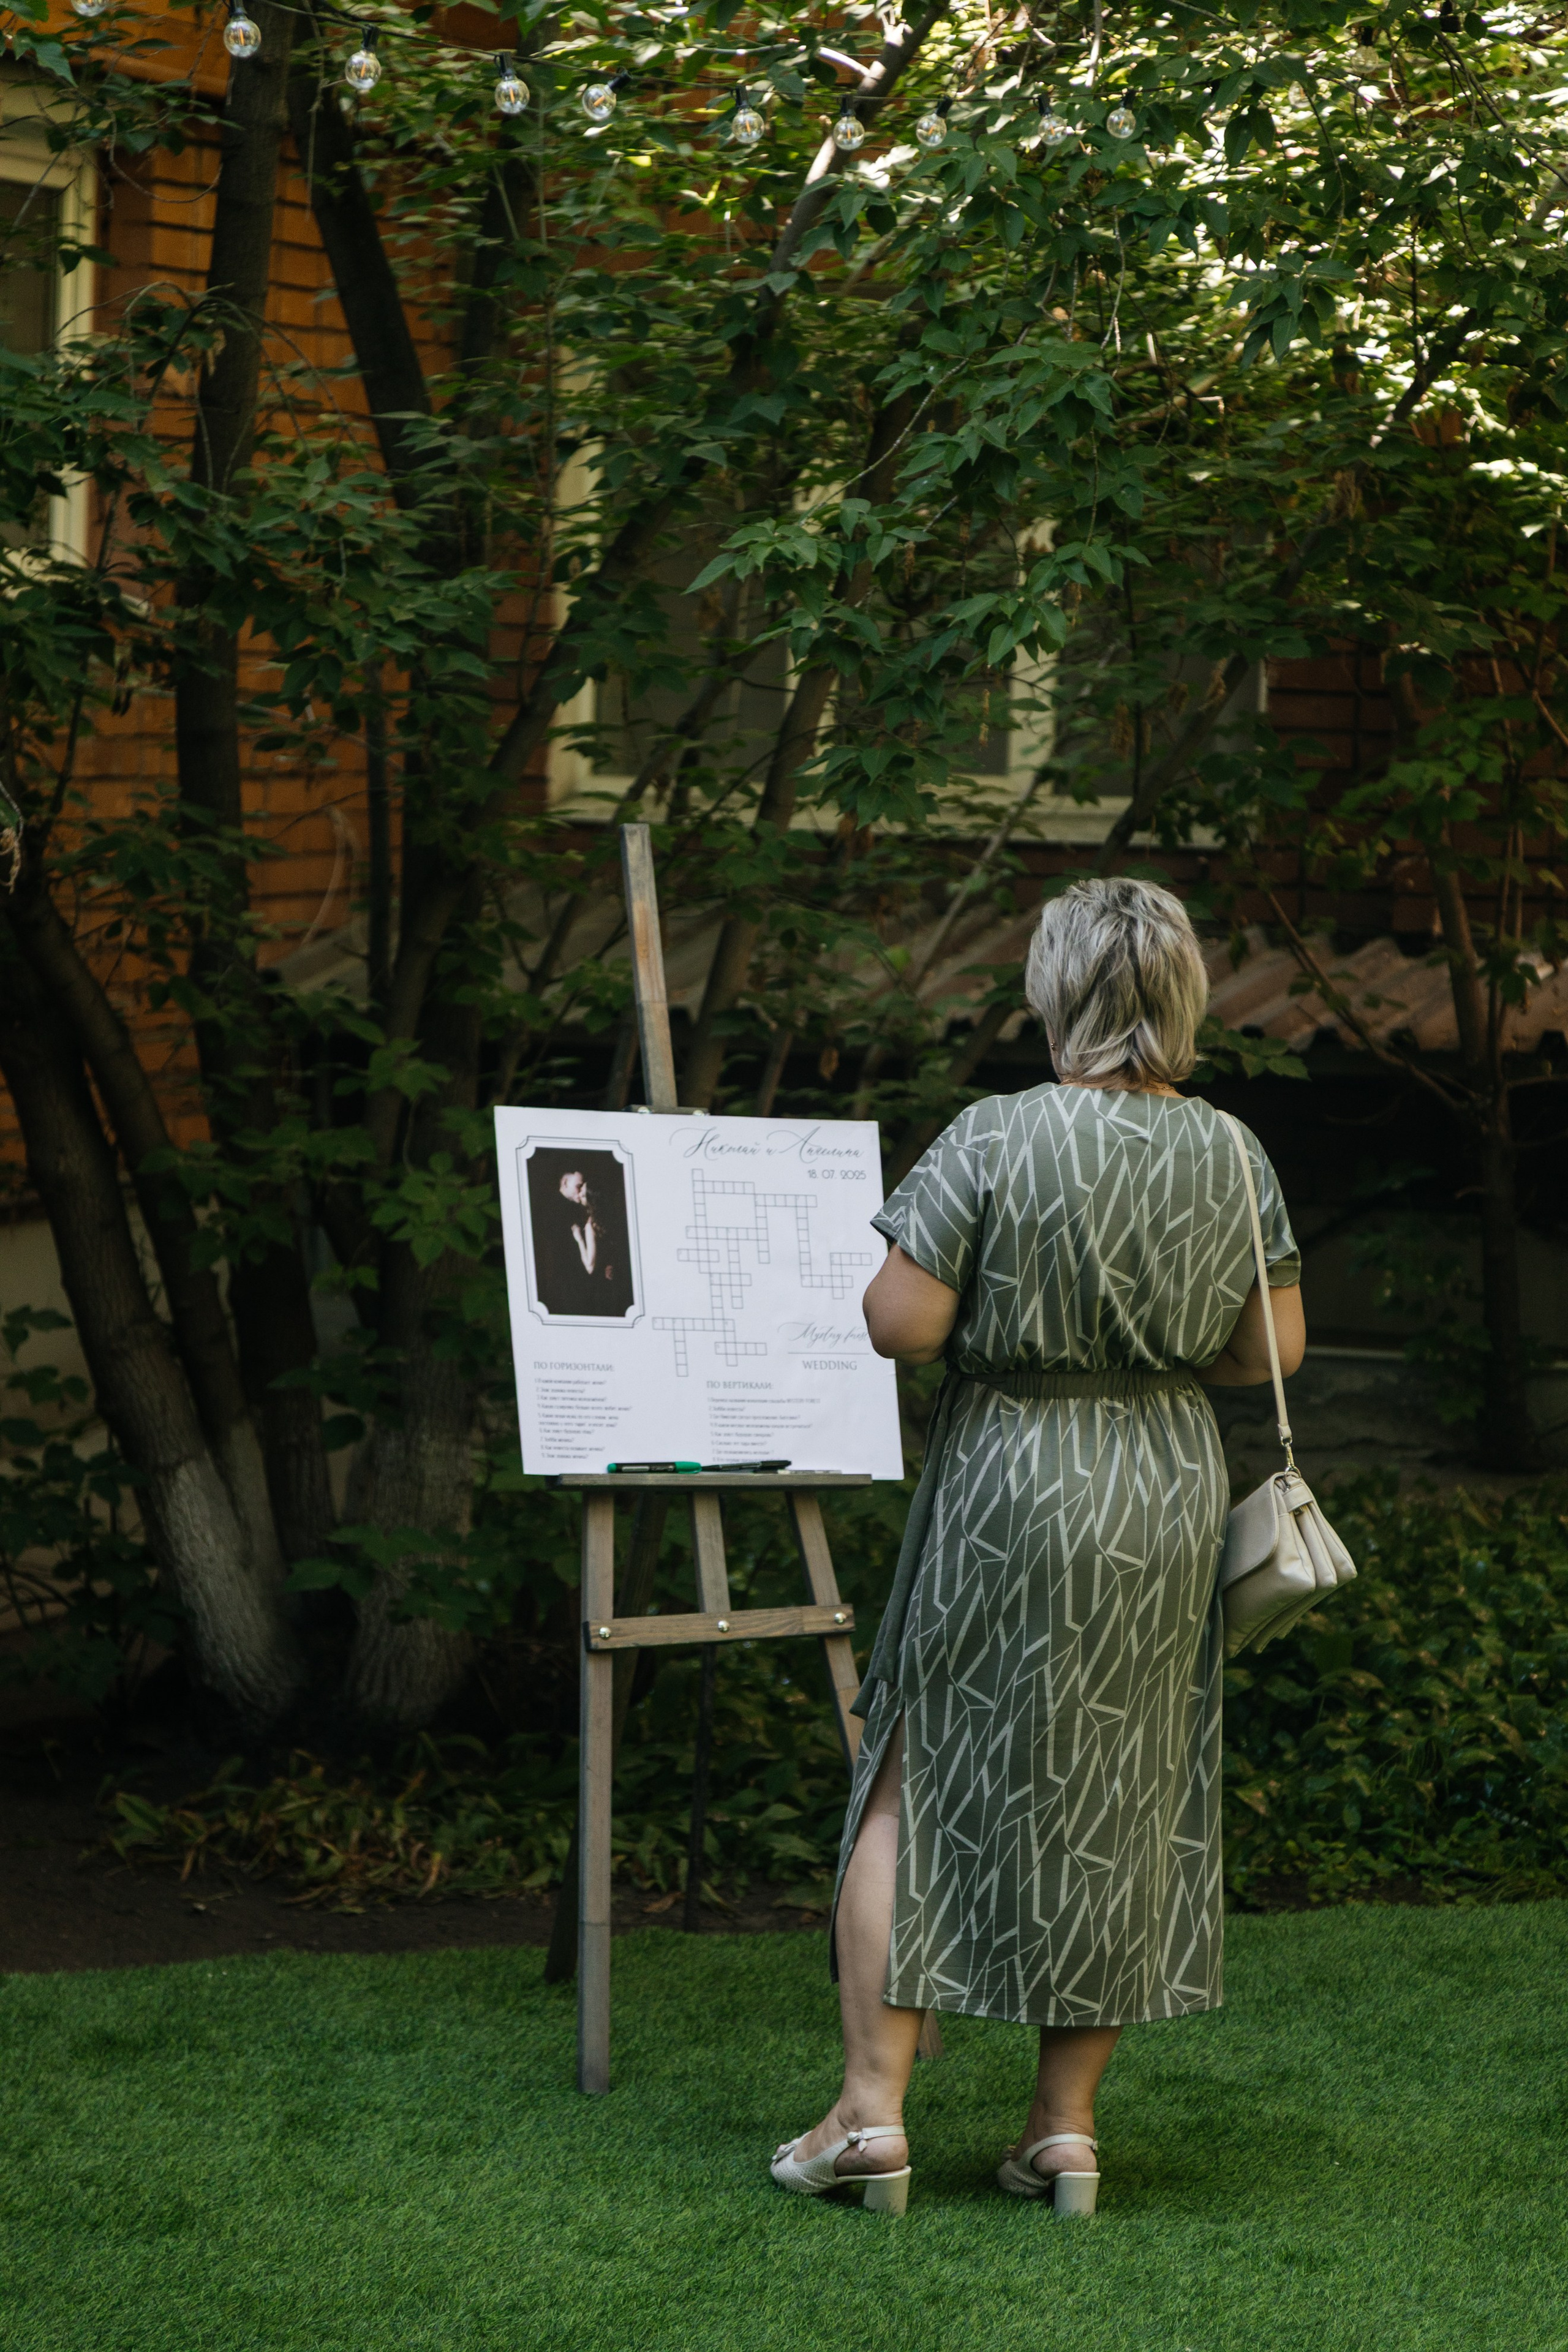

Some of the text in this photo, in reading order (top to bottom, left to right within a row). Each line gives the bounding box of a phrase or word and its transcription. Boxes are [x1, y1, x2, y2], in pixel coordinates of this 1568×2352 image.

[807, 1169, 867, 1180] 18. 07. 2025
[533, 1361, 548, 1370] ПО
[802, 1360, 858, 1371] WEDDING
[706, 1381, 720, 1389] ПО
